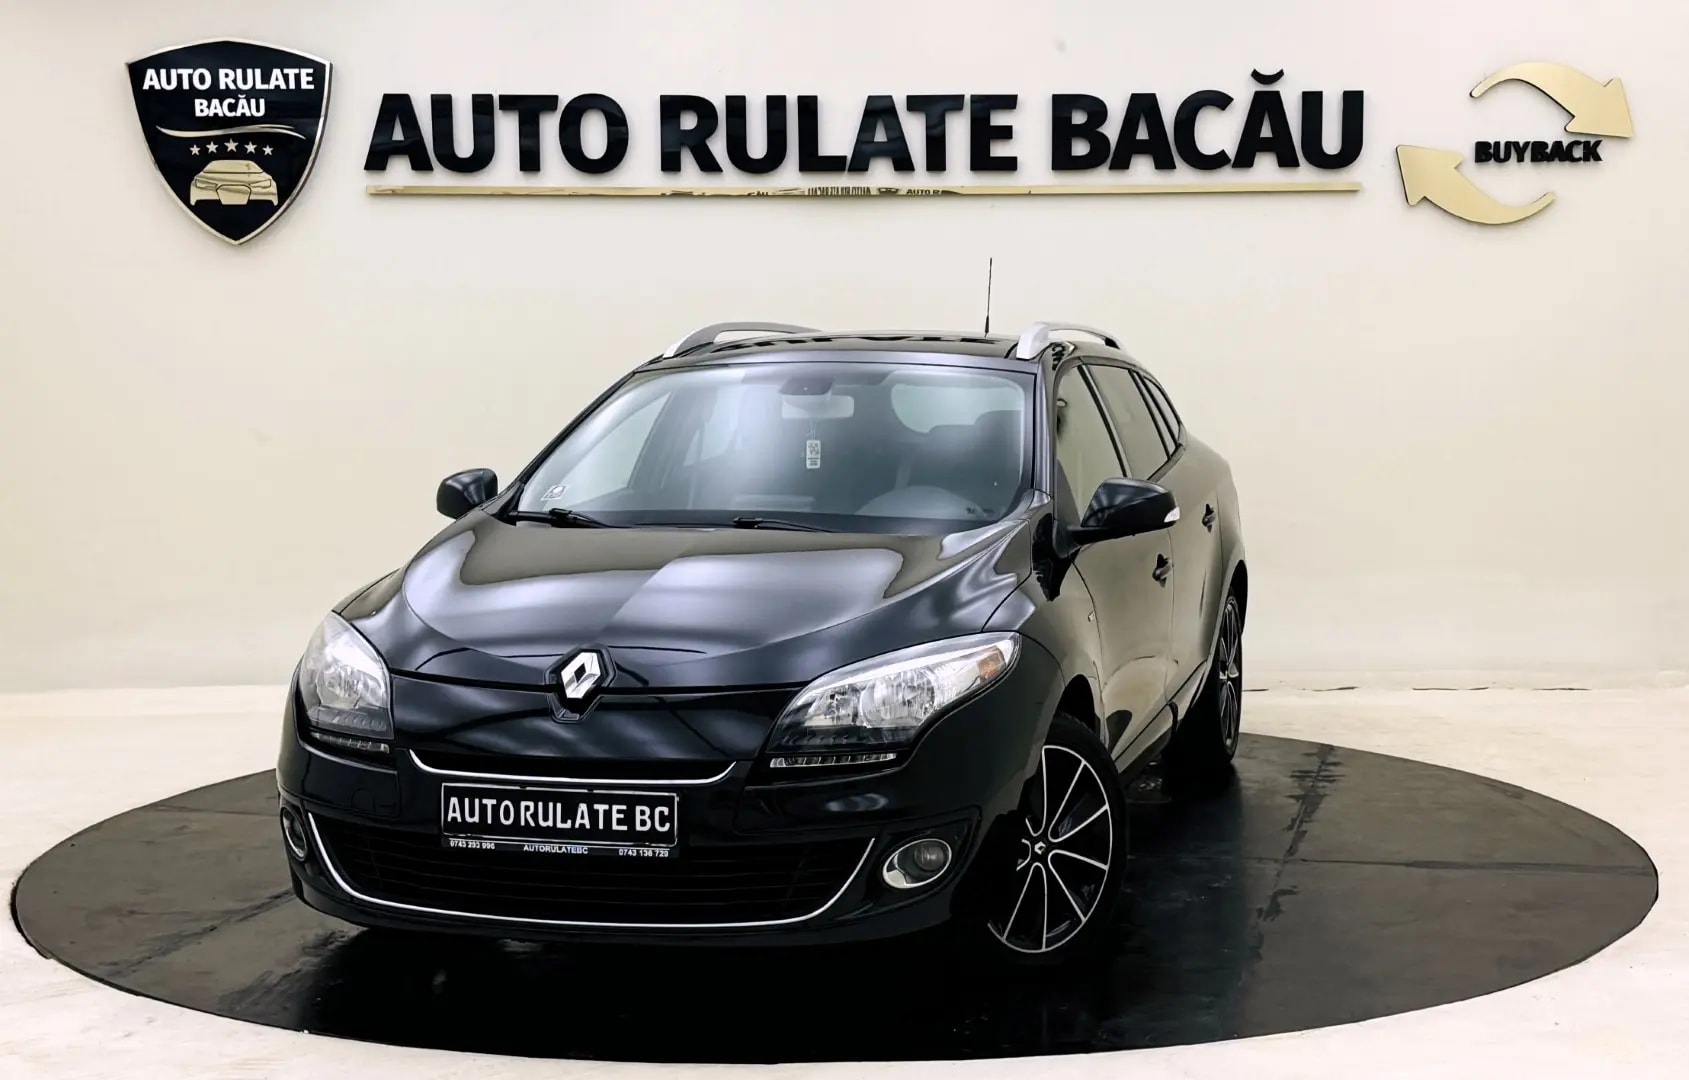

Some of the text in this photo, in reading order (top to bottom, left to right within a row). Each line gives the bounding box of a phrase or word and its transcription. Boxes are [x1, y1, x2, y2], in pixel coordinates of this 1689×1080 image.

[143, 68, 315, 91] AUTO RULATE
[194, 94, 266, 117] BACĂU
[364, 69, 1364, 175] AUTO RULATE BACĂU
[1475, 139, 1603, 163] BUYBACK
[447, 796, 671, 832] AUTO RULATE BC
[523, 844, 589, 854] AUTORULATEBC
[618, 849, 637, 857] 0743
